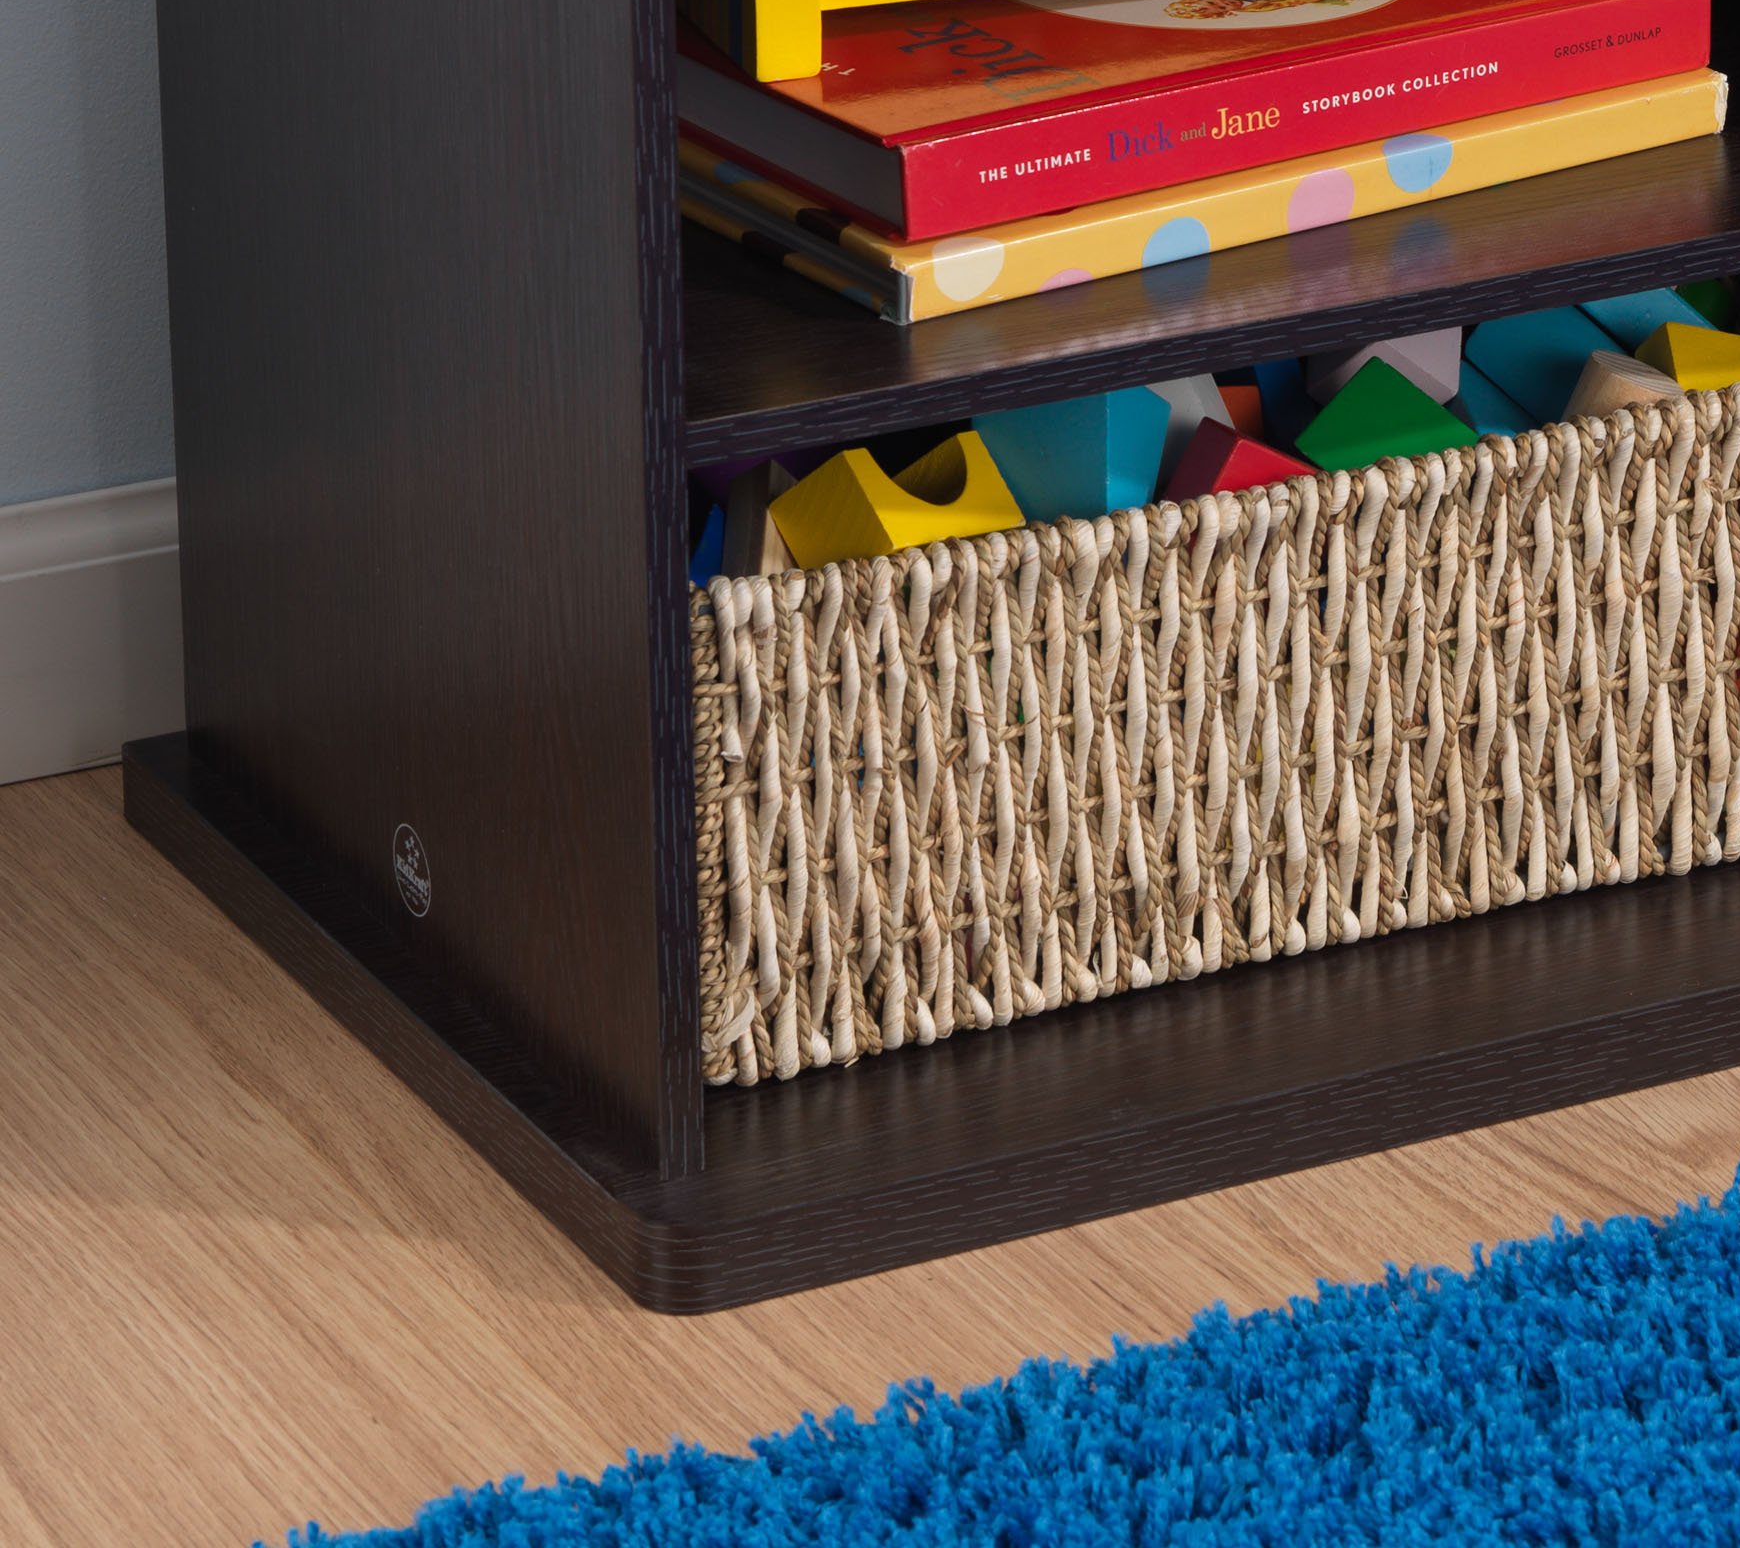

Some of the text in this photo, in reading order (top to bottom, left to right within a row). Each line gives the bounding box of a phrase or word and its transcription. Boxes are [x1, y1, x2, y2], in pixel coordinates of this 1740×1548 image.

[821, 61, 856, 77] TH
[897, 19, 1099, 101] Dick
[1553, 27, 1662, 59] GROSSET & DUNLAP
[979, 61, 1499, 184] THE ULTIMATE Dick and Jane STORYBOOK COLLECTION
